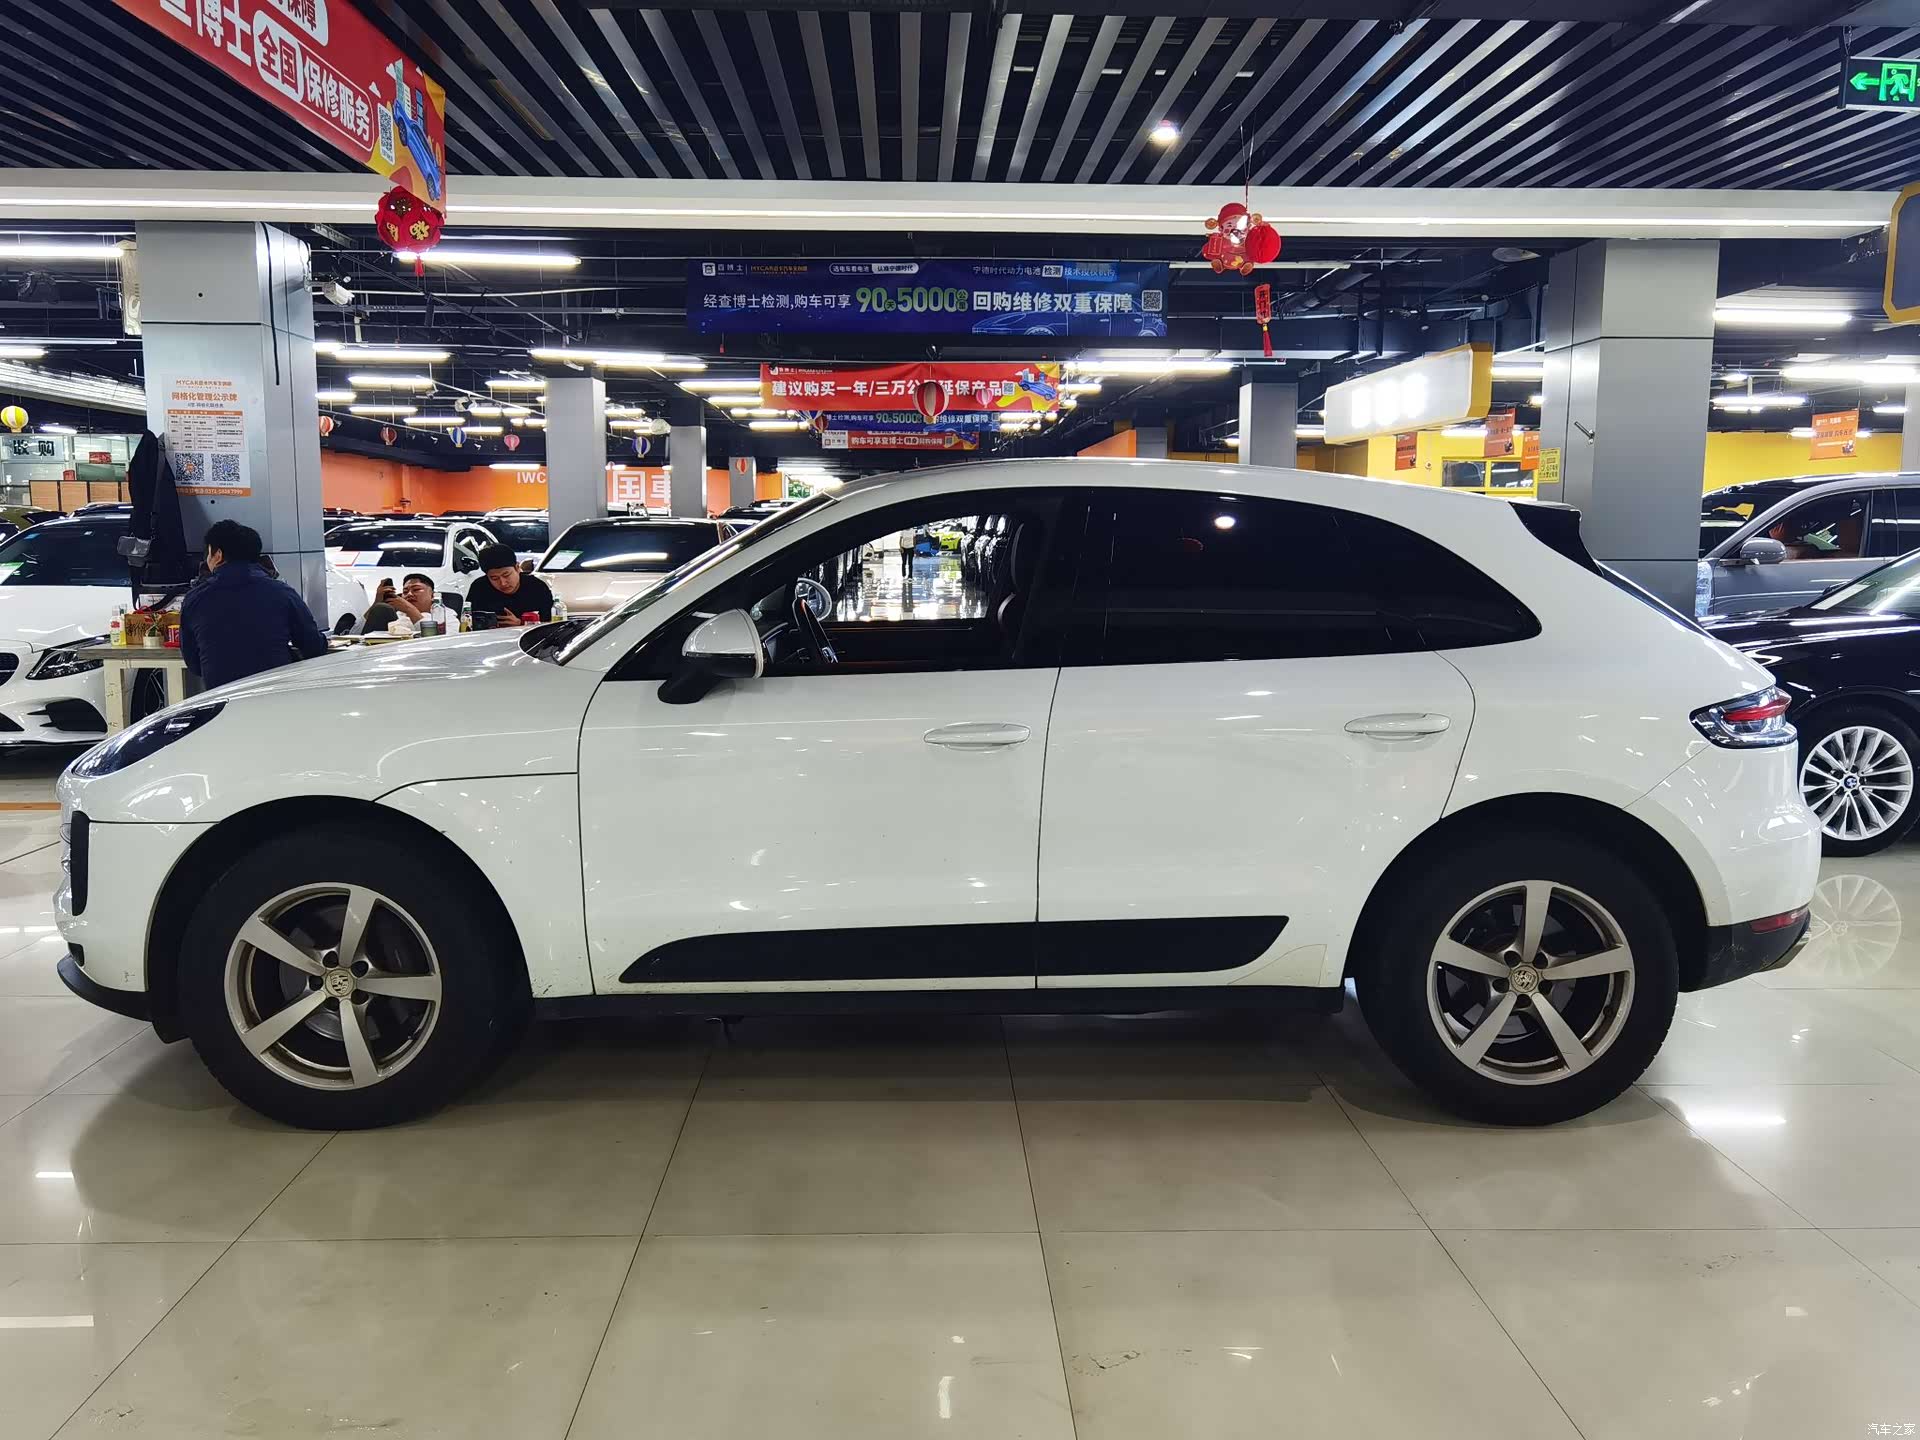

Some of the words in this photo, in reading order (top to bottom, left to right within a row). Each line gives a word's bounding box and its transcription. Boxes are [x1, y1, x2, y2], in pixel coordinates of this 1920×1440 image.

[258, 25, 298, 87] 全国
[304, 56, 371, 142] 保修服务
[703, 293, 852, 311] 经查博士检测,购车可享
[973, 290, 1133, 313] 回购维修双重保障
[171, 391, 237, 401] 网格化管理公示牌
